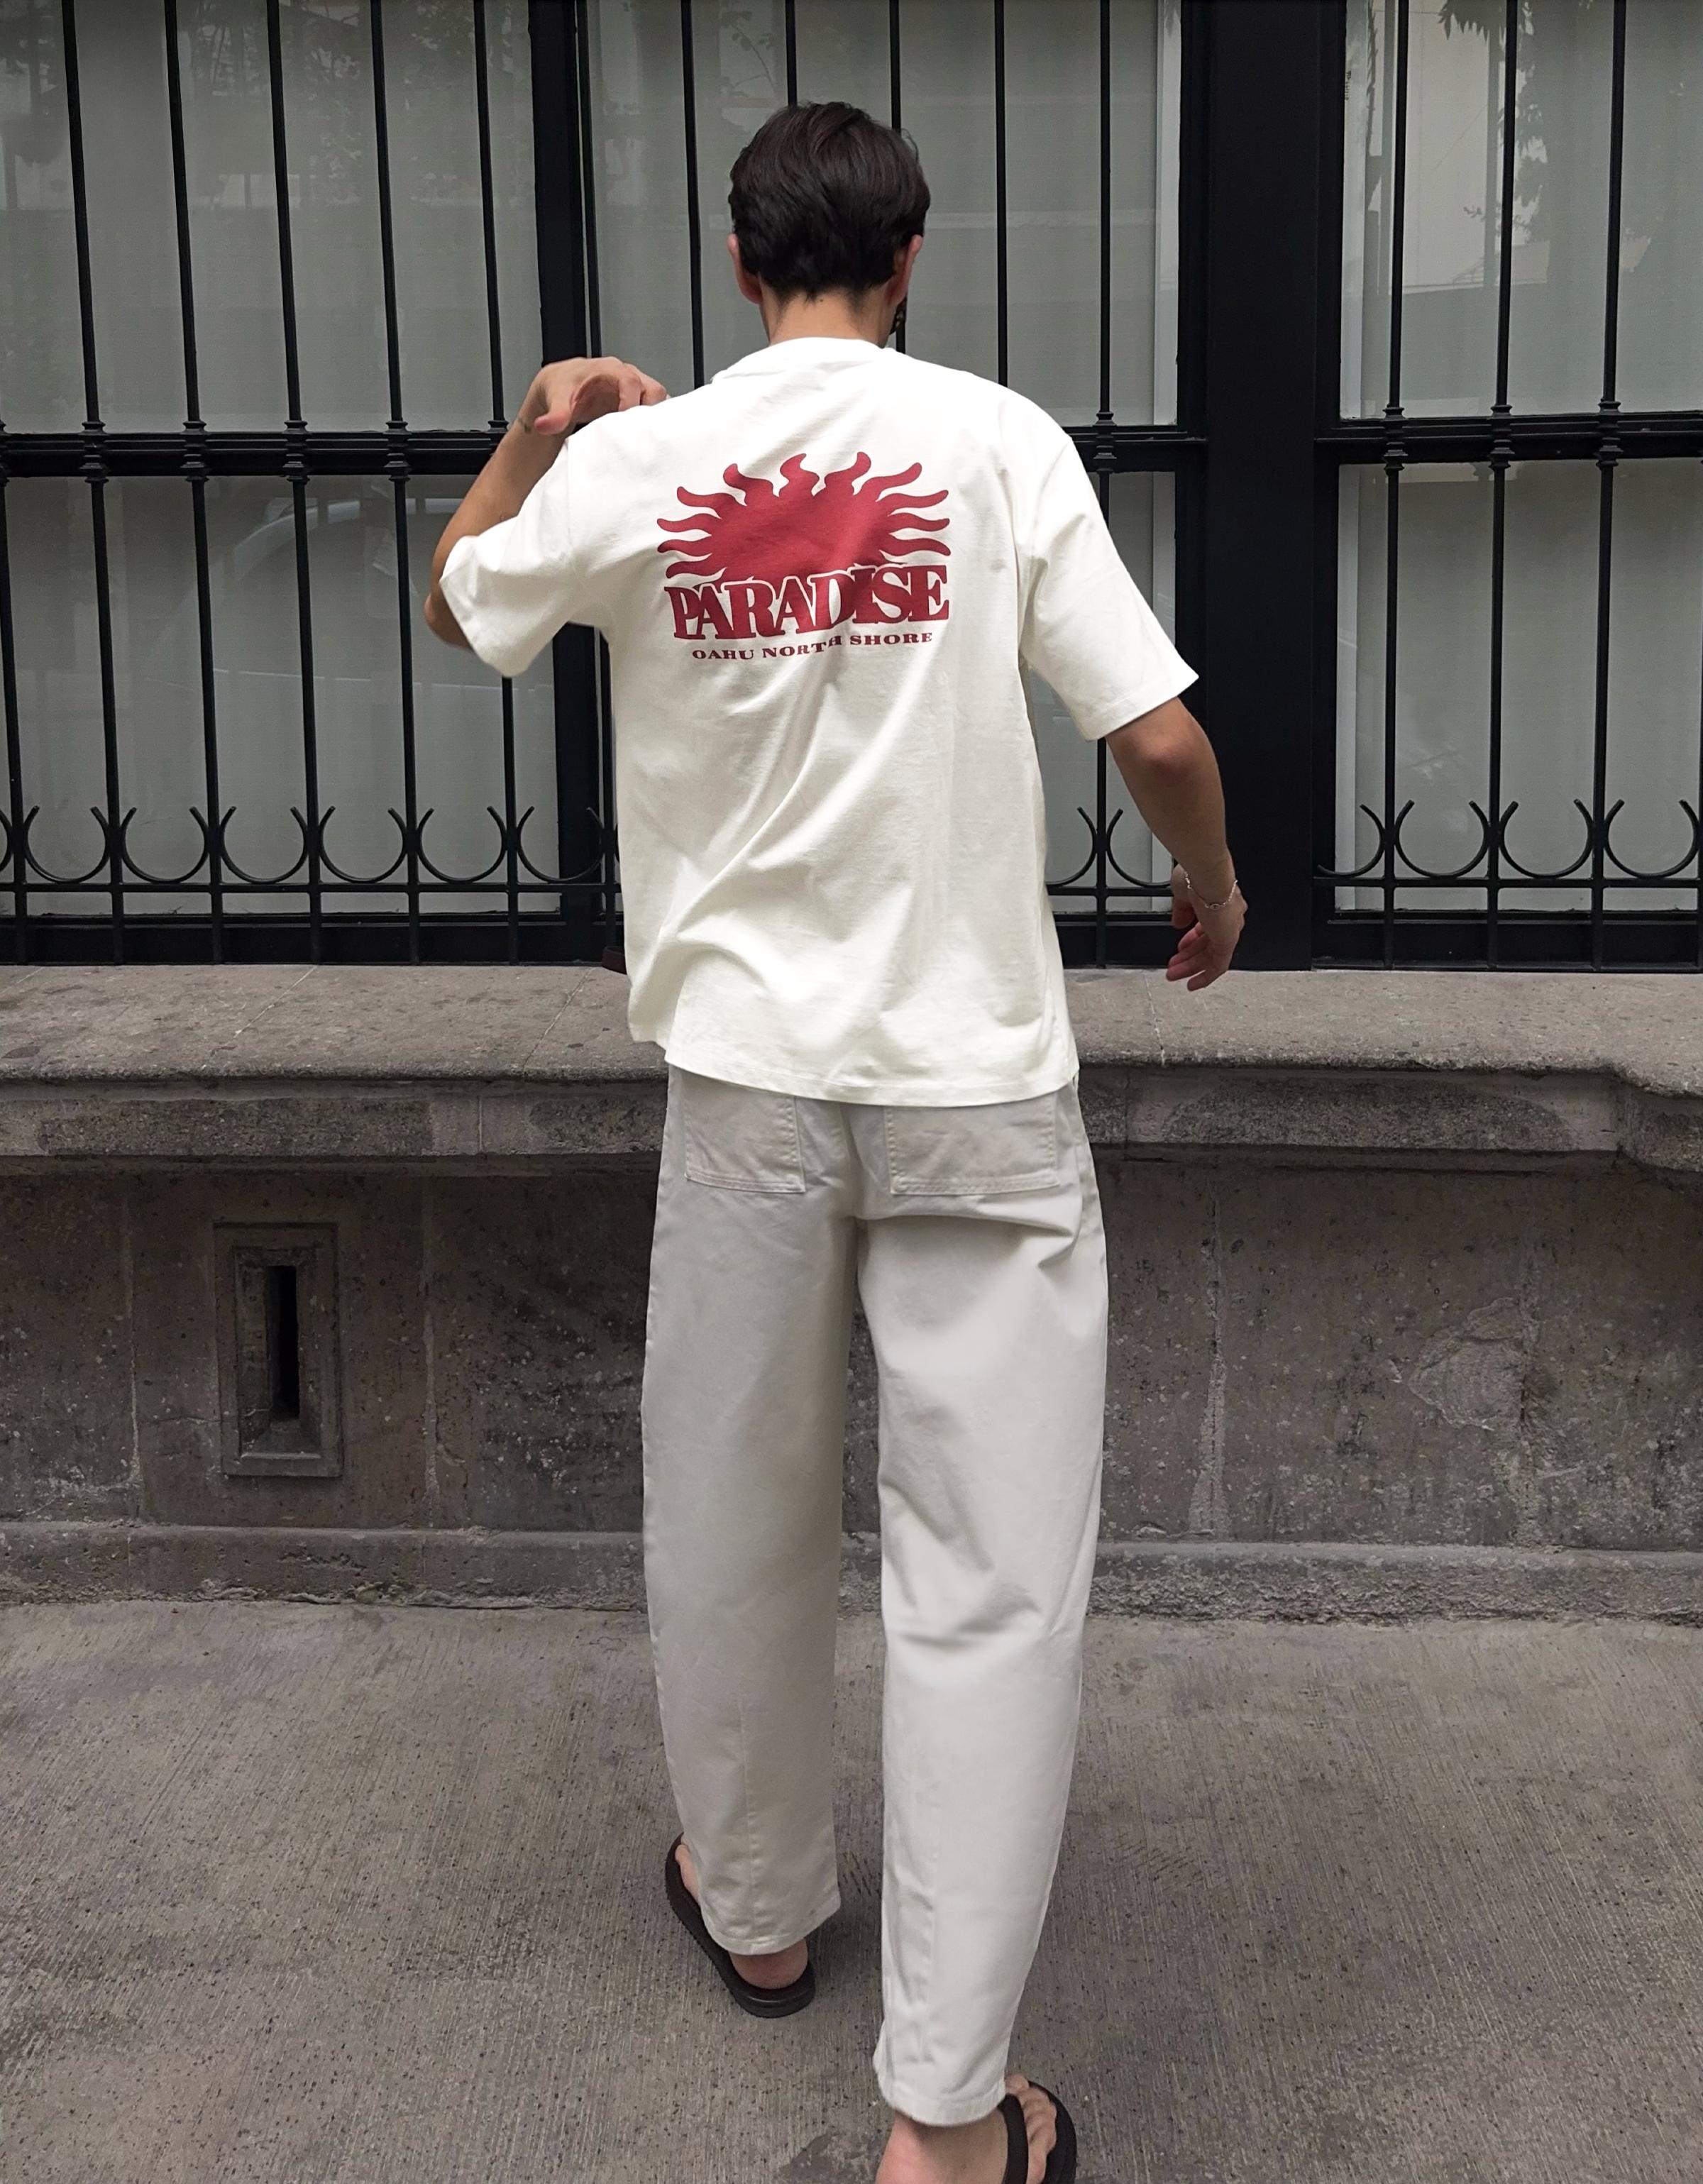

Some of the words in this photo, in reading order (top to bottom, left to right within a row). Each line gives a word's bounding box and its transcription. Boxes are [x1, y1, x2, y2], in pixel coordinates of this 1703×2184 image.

[664, 564, 950, 640] PARADISE
[692, 646, 754, 660] OAHU
[762, 635, 842, 658] NORTH
[849, 632, 933, 645] SHORE
